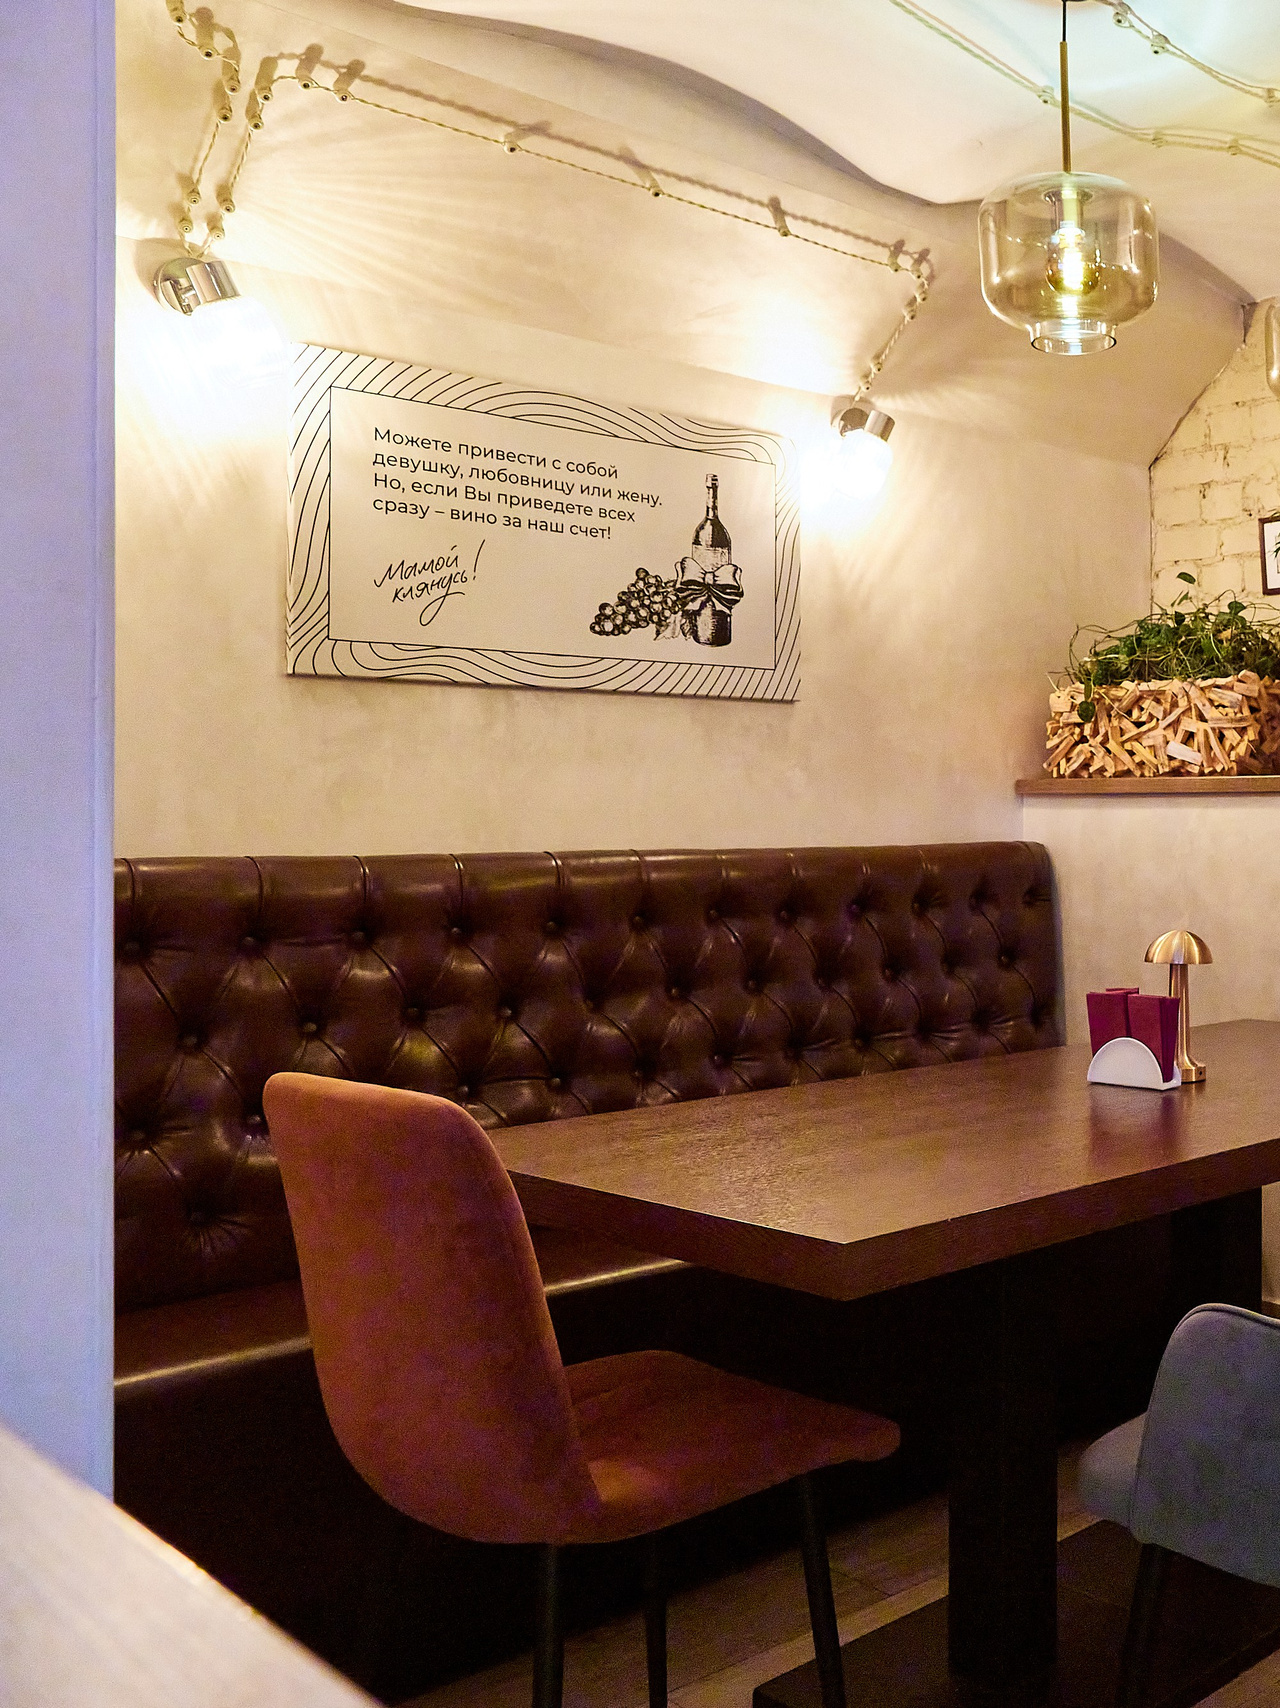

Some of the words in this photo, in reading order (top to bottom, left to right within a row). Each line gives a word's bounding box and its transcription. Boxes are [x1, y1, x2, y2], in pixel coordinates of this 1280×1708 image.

[374, 426, 453, 453] Можете
[458, 443, 547, 469] привести
[552, 458, 562, 470] с
[566, 461, 618, 479] собой
[372, 452, 464, 480] девушку,
[468, 466, 576, 496] любовницу
[580, 483, 612, 499] или
[617, 489, 663, 508] жену.
[374, 472, 406, 494] Но,
[411, 481, 458, 499] если
[464, 485, 491, 503] Вы
[497, 492, 594, 517] приведете
[598, 507, 636, 523] всех
[372, 498, 431, 520] сразу
[450, 508, 498, 525] вино
[502, 515, 522, 528] за
[527, 518, 565, 534] наш
[569, 525, 611, 540] счет!
